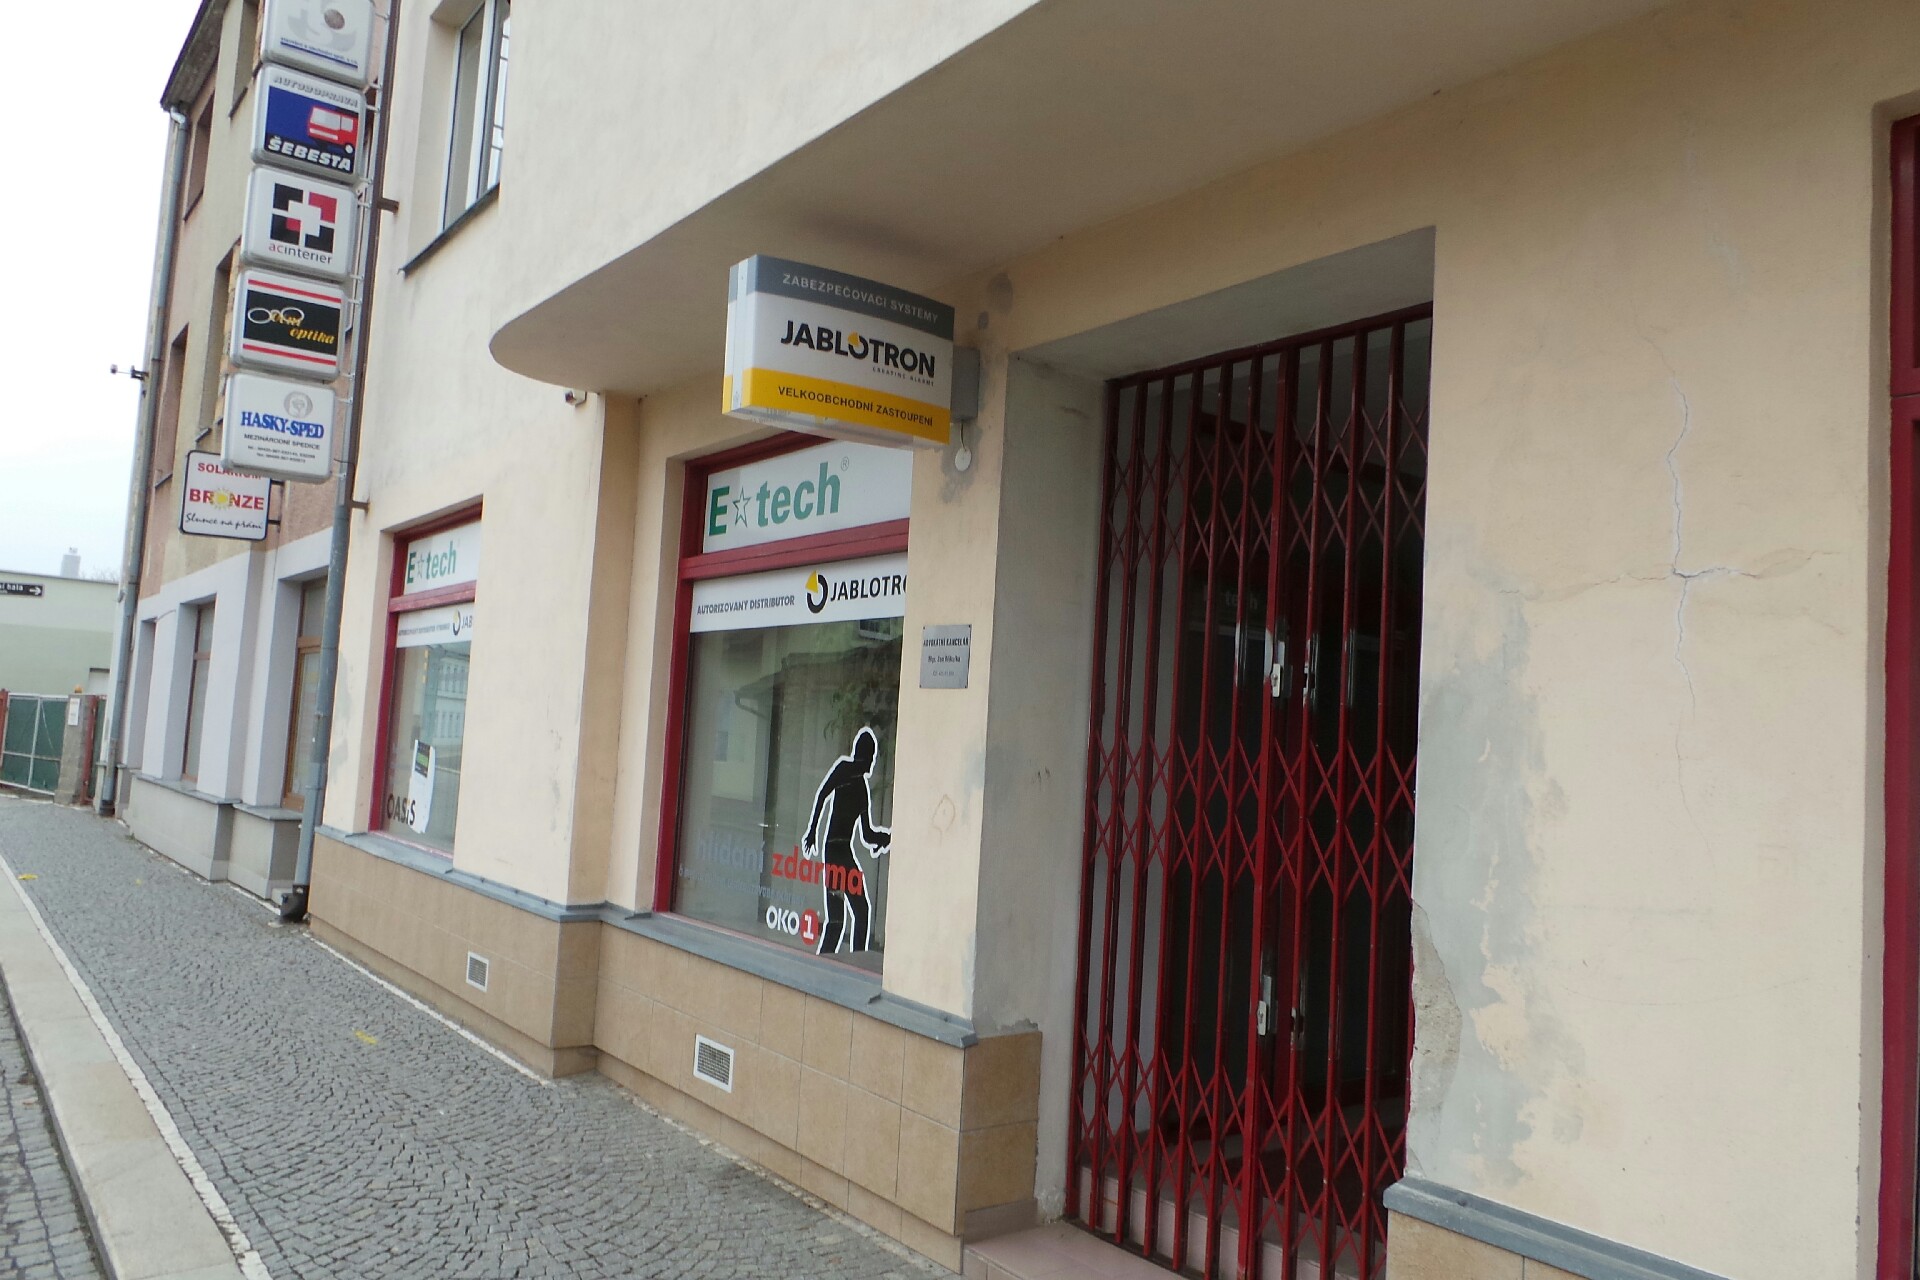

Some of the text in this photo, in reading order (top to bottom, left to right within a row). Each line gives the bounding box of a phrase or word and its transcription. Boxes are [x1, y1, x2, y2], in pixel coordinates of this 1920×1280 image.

[268, 135, 351, 172] ŠEBESTA
[269, 243, 332, 264] acinterier
[290, 328, 335, 344] optika
[781, 320, 935, 378] JABLOTRON
[778, 386, 933, 427] VELKOOBCHODNÍ ZASTOUPENÍ
[240, 411, 325, 439] HASKY-SPED
[749, 595, 795, 610] DISTRIBUTOR
[771, 845, 863, 896] zdarma
[766, 905, 800, 935] OKO
